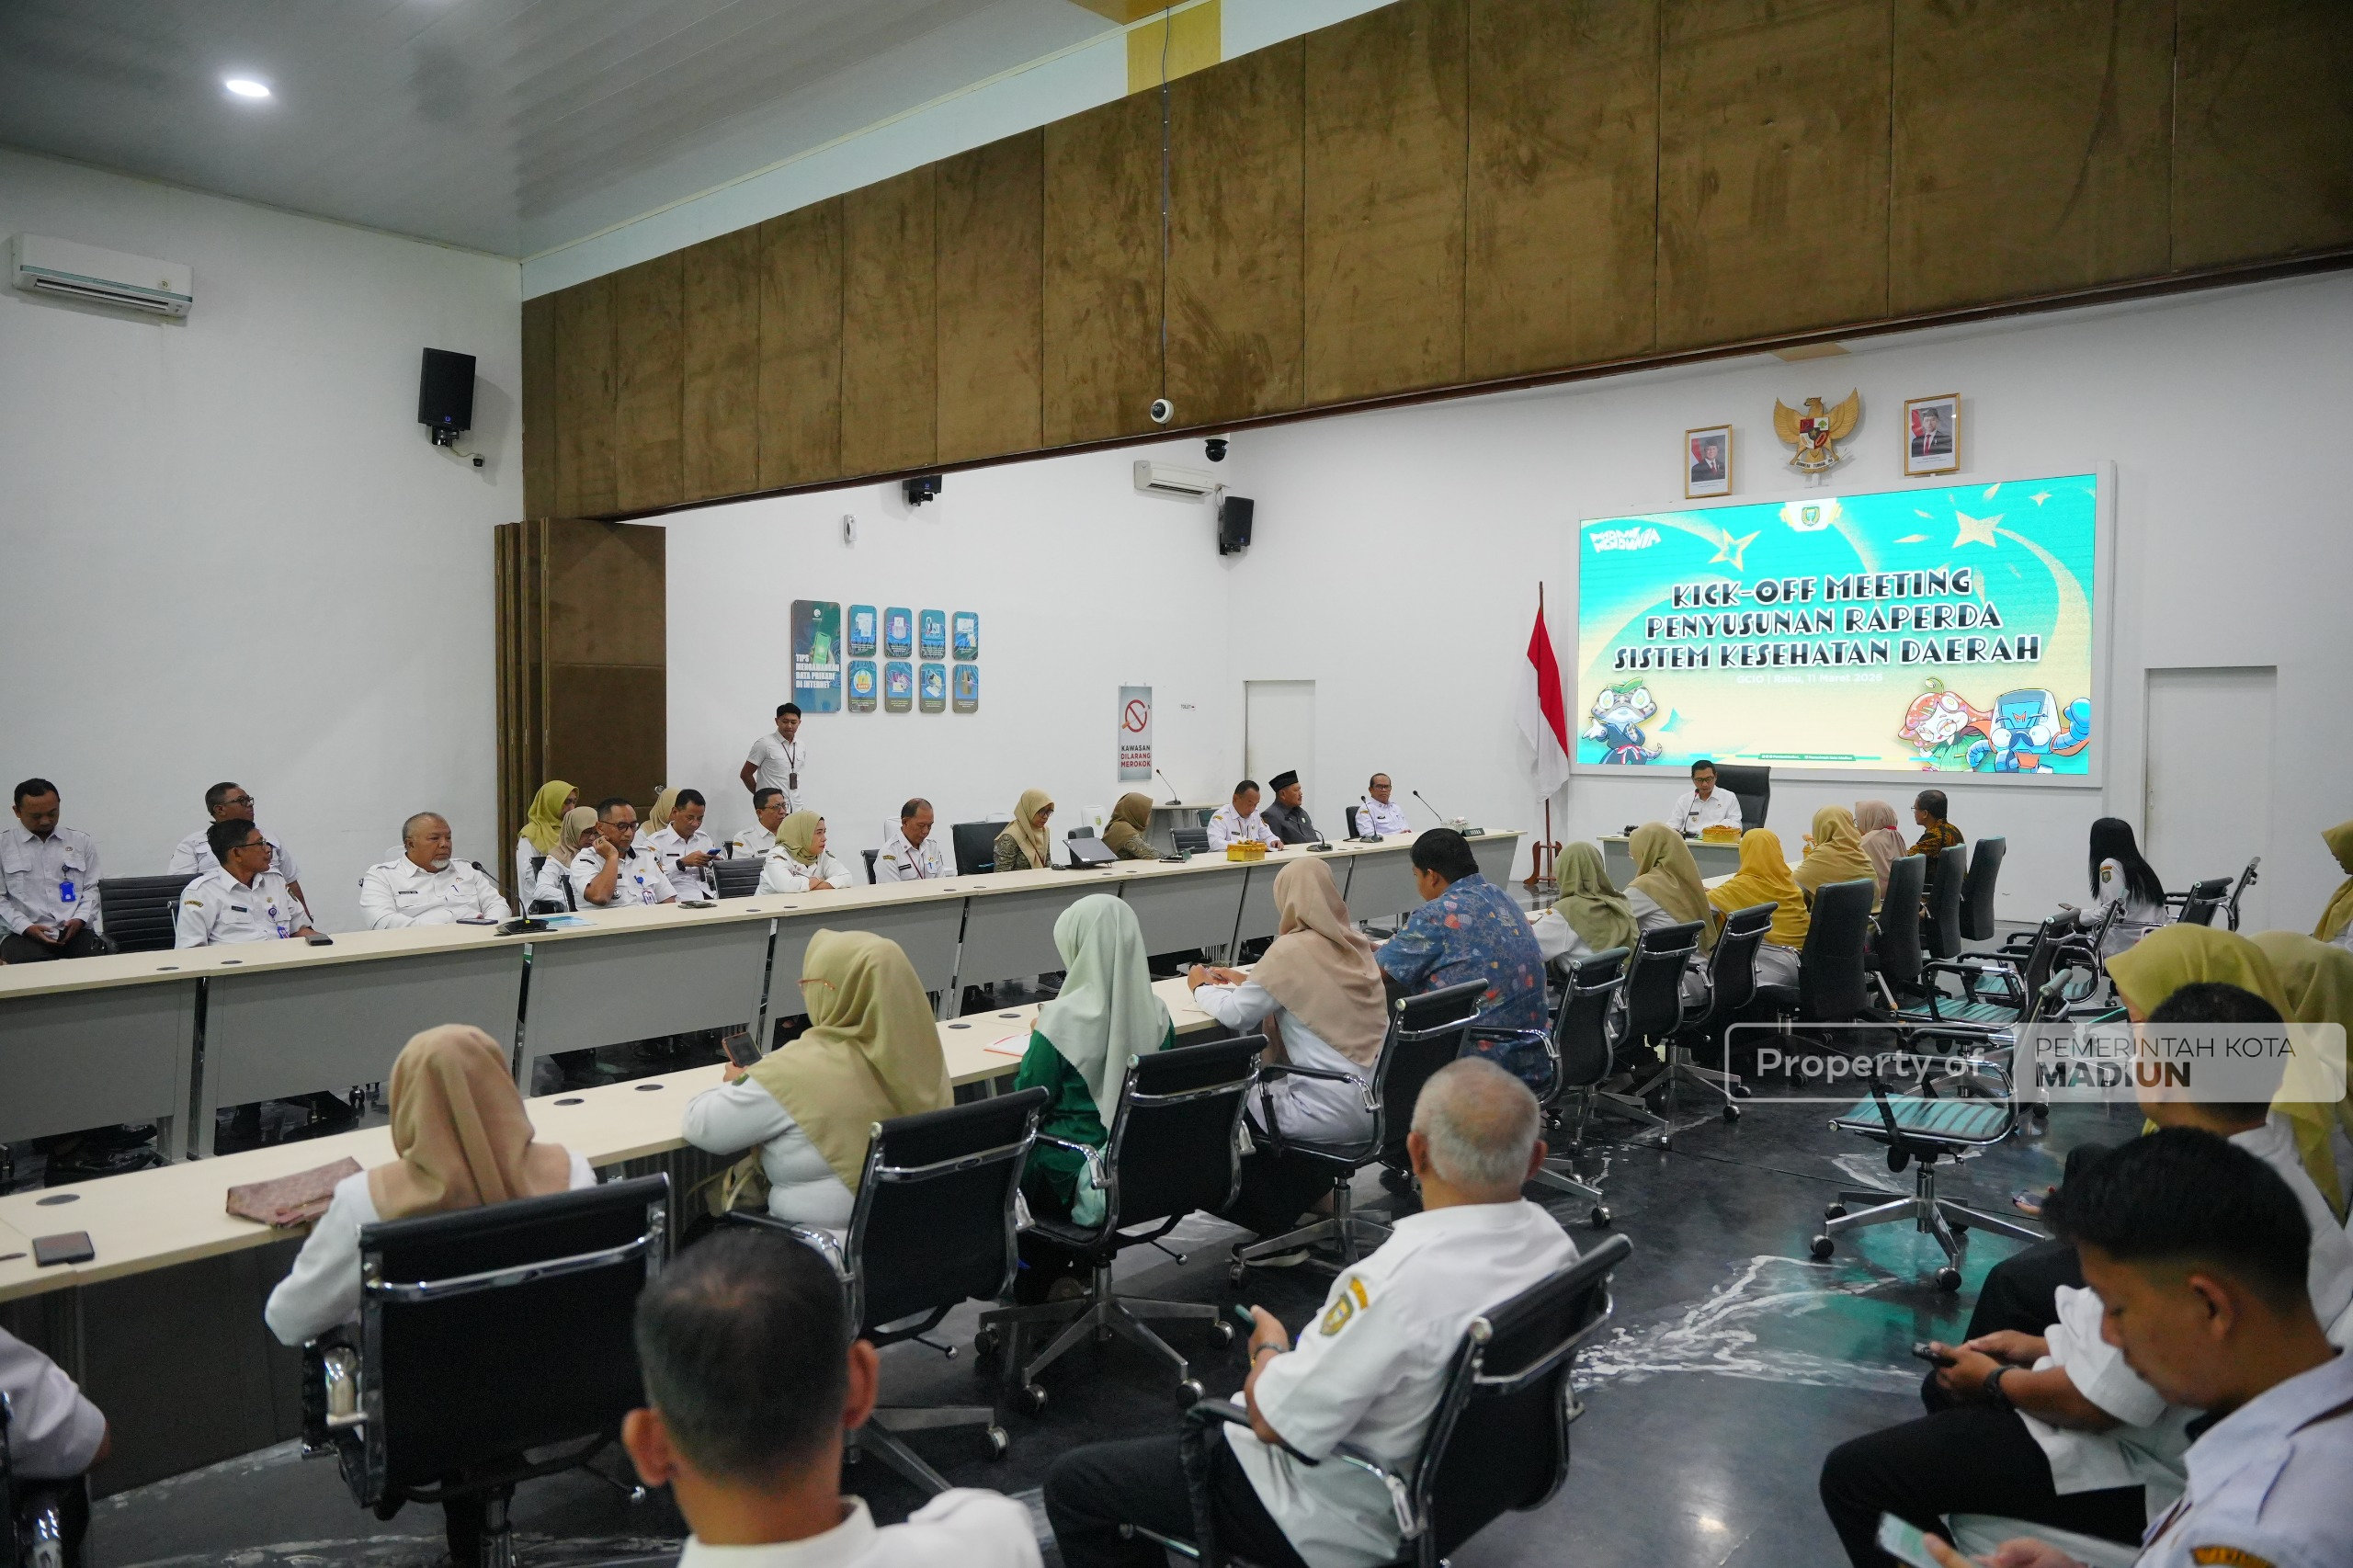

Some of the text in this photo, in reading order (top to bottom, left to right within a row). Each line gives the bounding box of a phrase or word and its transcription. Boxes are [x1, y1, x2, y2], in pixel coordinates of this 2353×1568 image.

[1673, 568, 1971, 608] KICK-OFF MEETING
[1646, 602, 2002, 639] PENYUSUNAN RAPERDA
[796, 653, 809, 662] TIPS
[1613, 635, 2040, 669] SISTEM KESEHATAN DAERAH
[803, 680, 830, 688] INTERNET
[1736, 675, 1765, 684] GCIO
[1773, 674, 1804, 685] Rabu,
[1819, 673, 1851, 683] Maret
